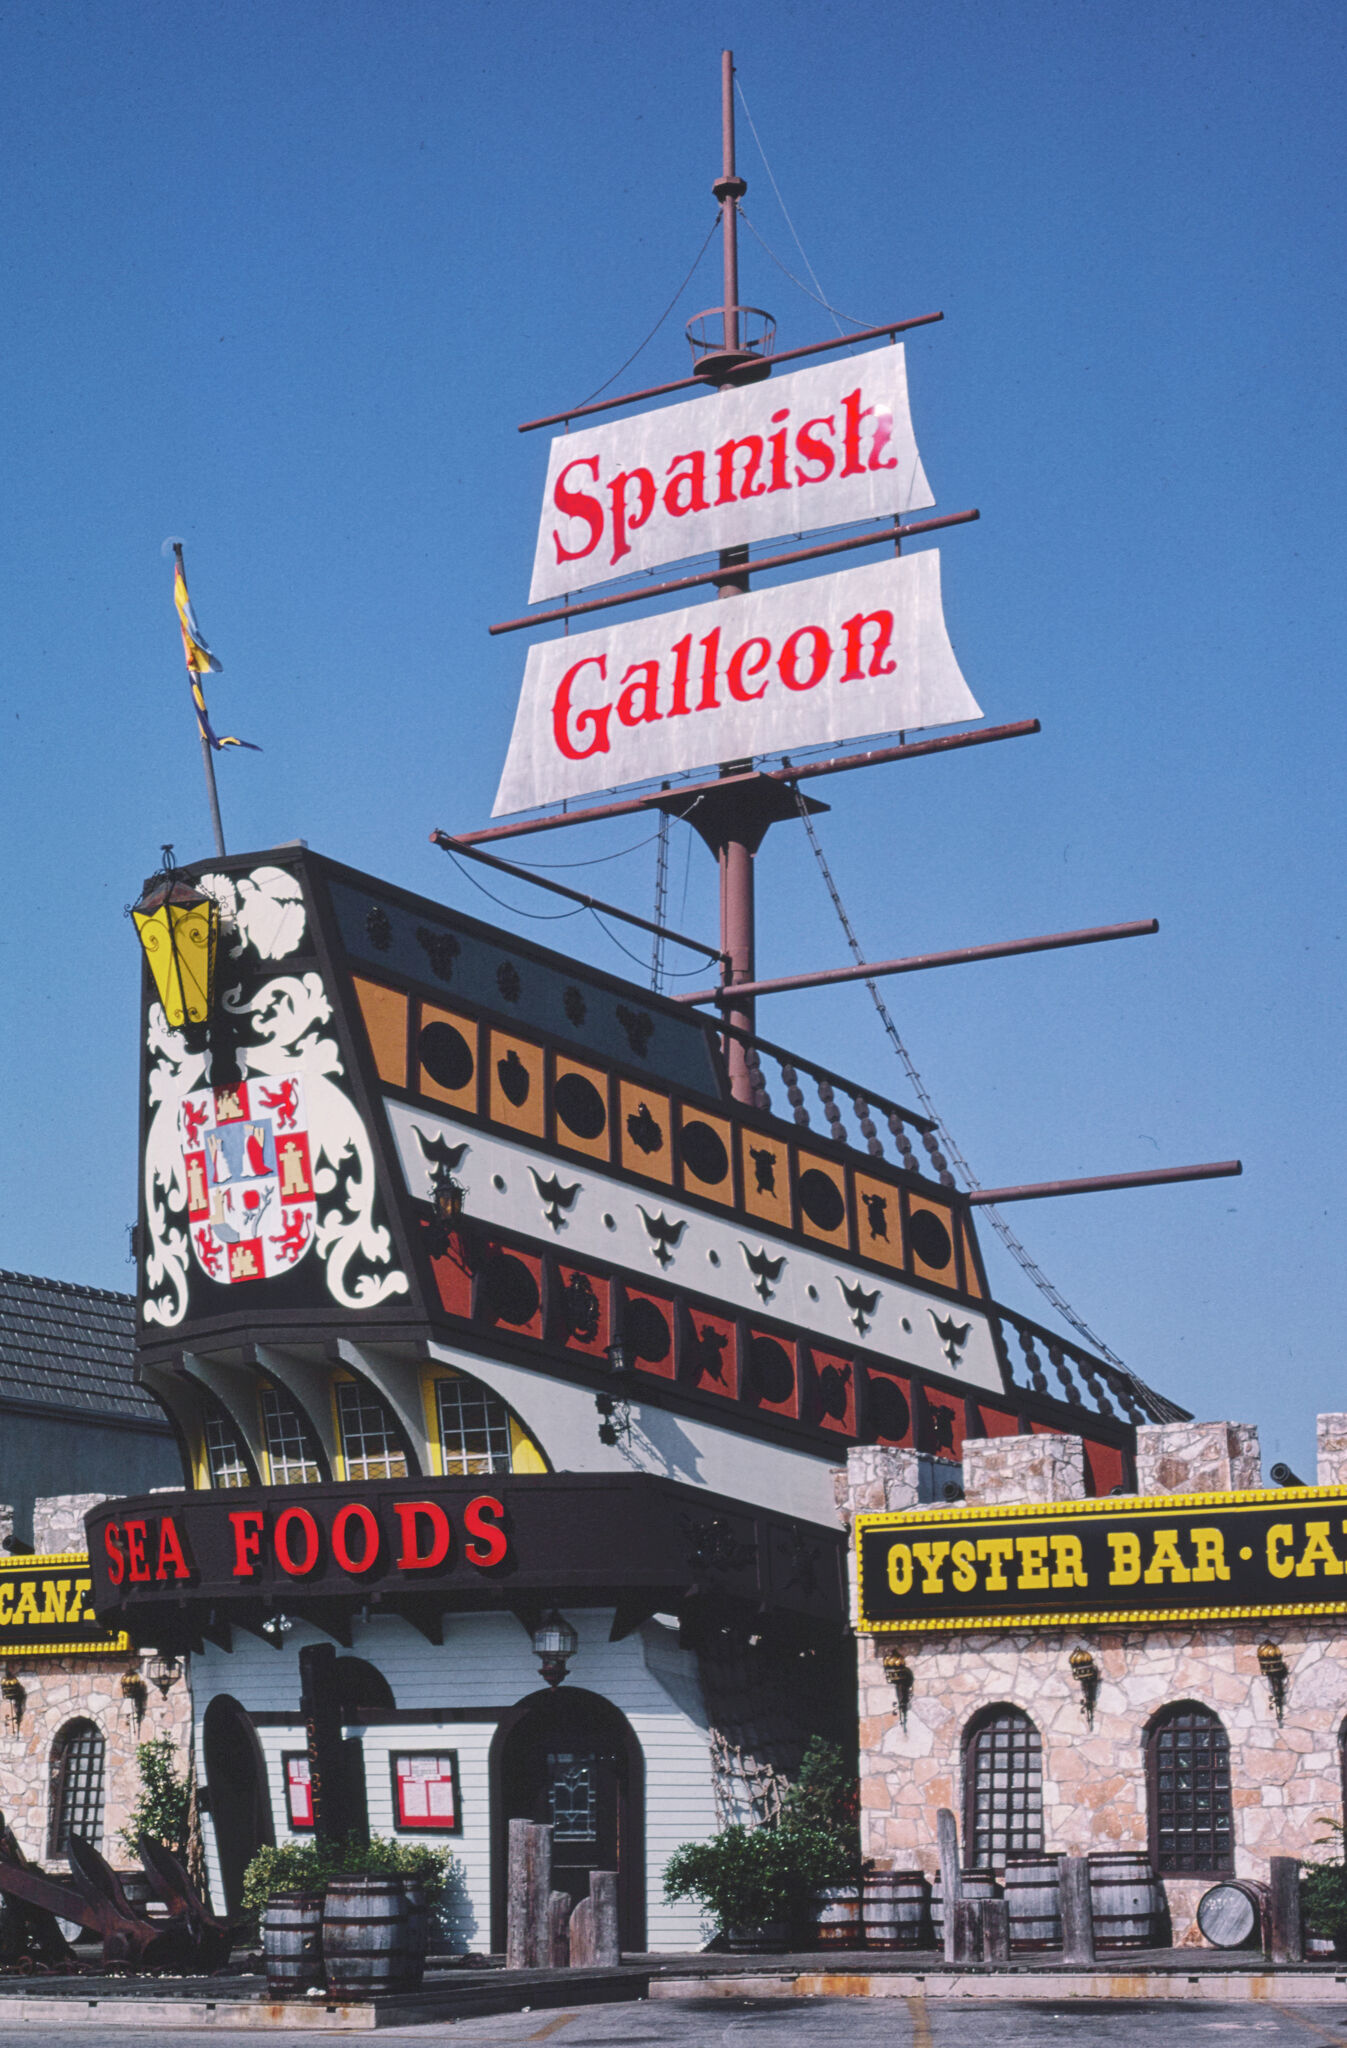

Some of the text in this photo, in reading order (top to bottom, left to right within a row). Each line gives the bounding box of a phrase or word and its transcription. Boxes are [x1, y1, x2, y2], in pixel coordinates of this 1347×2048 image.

[551, 387, 899, 567] Spanish
[550, 608, 898, 762] Galleon
[103, 1494, 509, 1586] SEA FOODS
[886, 1519, 1347, 1596] OYSTER BAR CA
